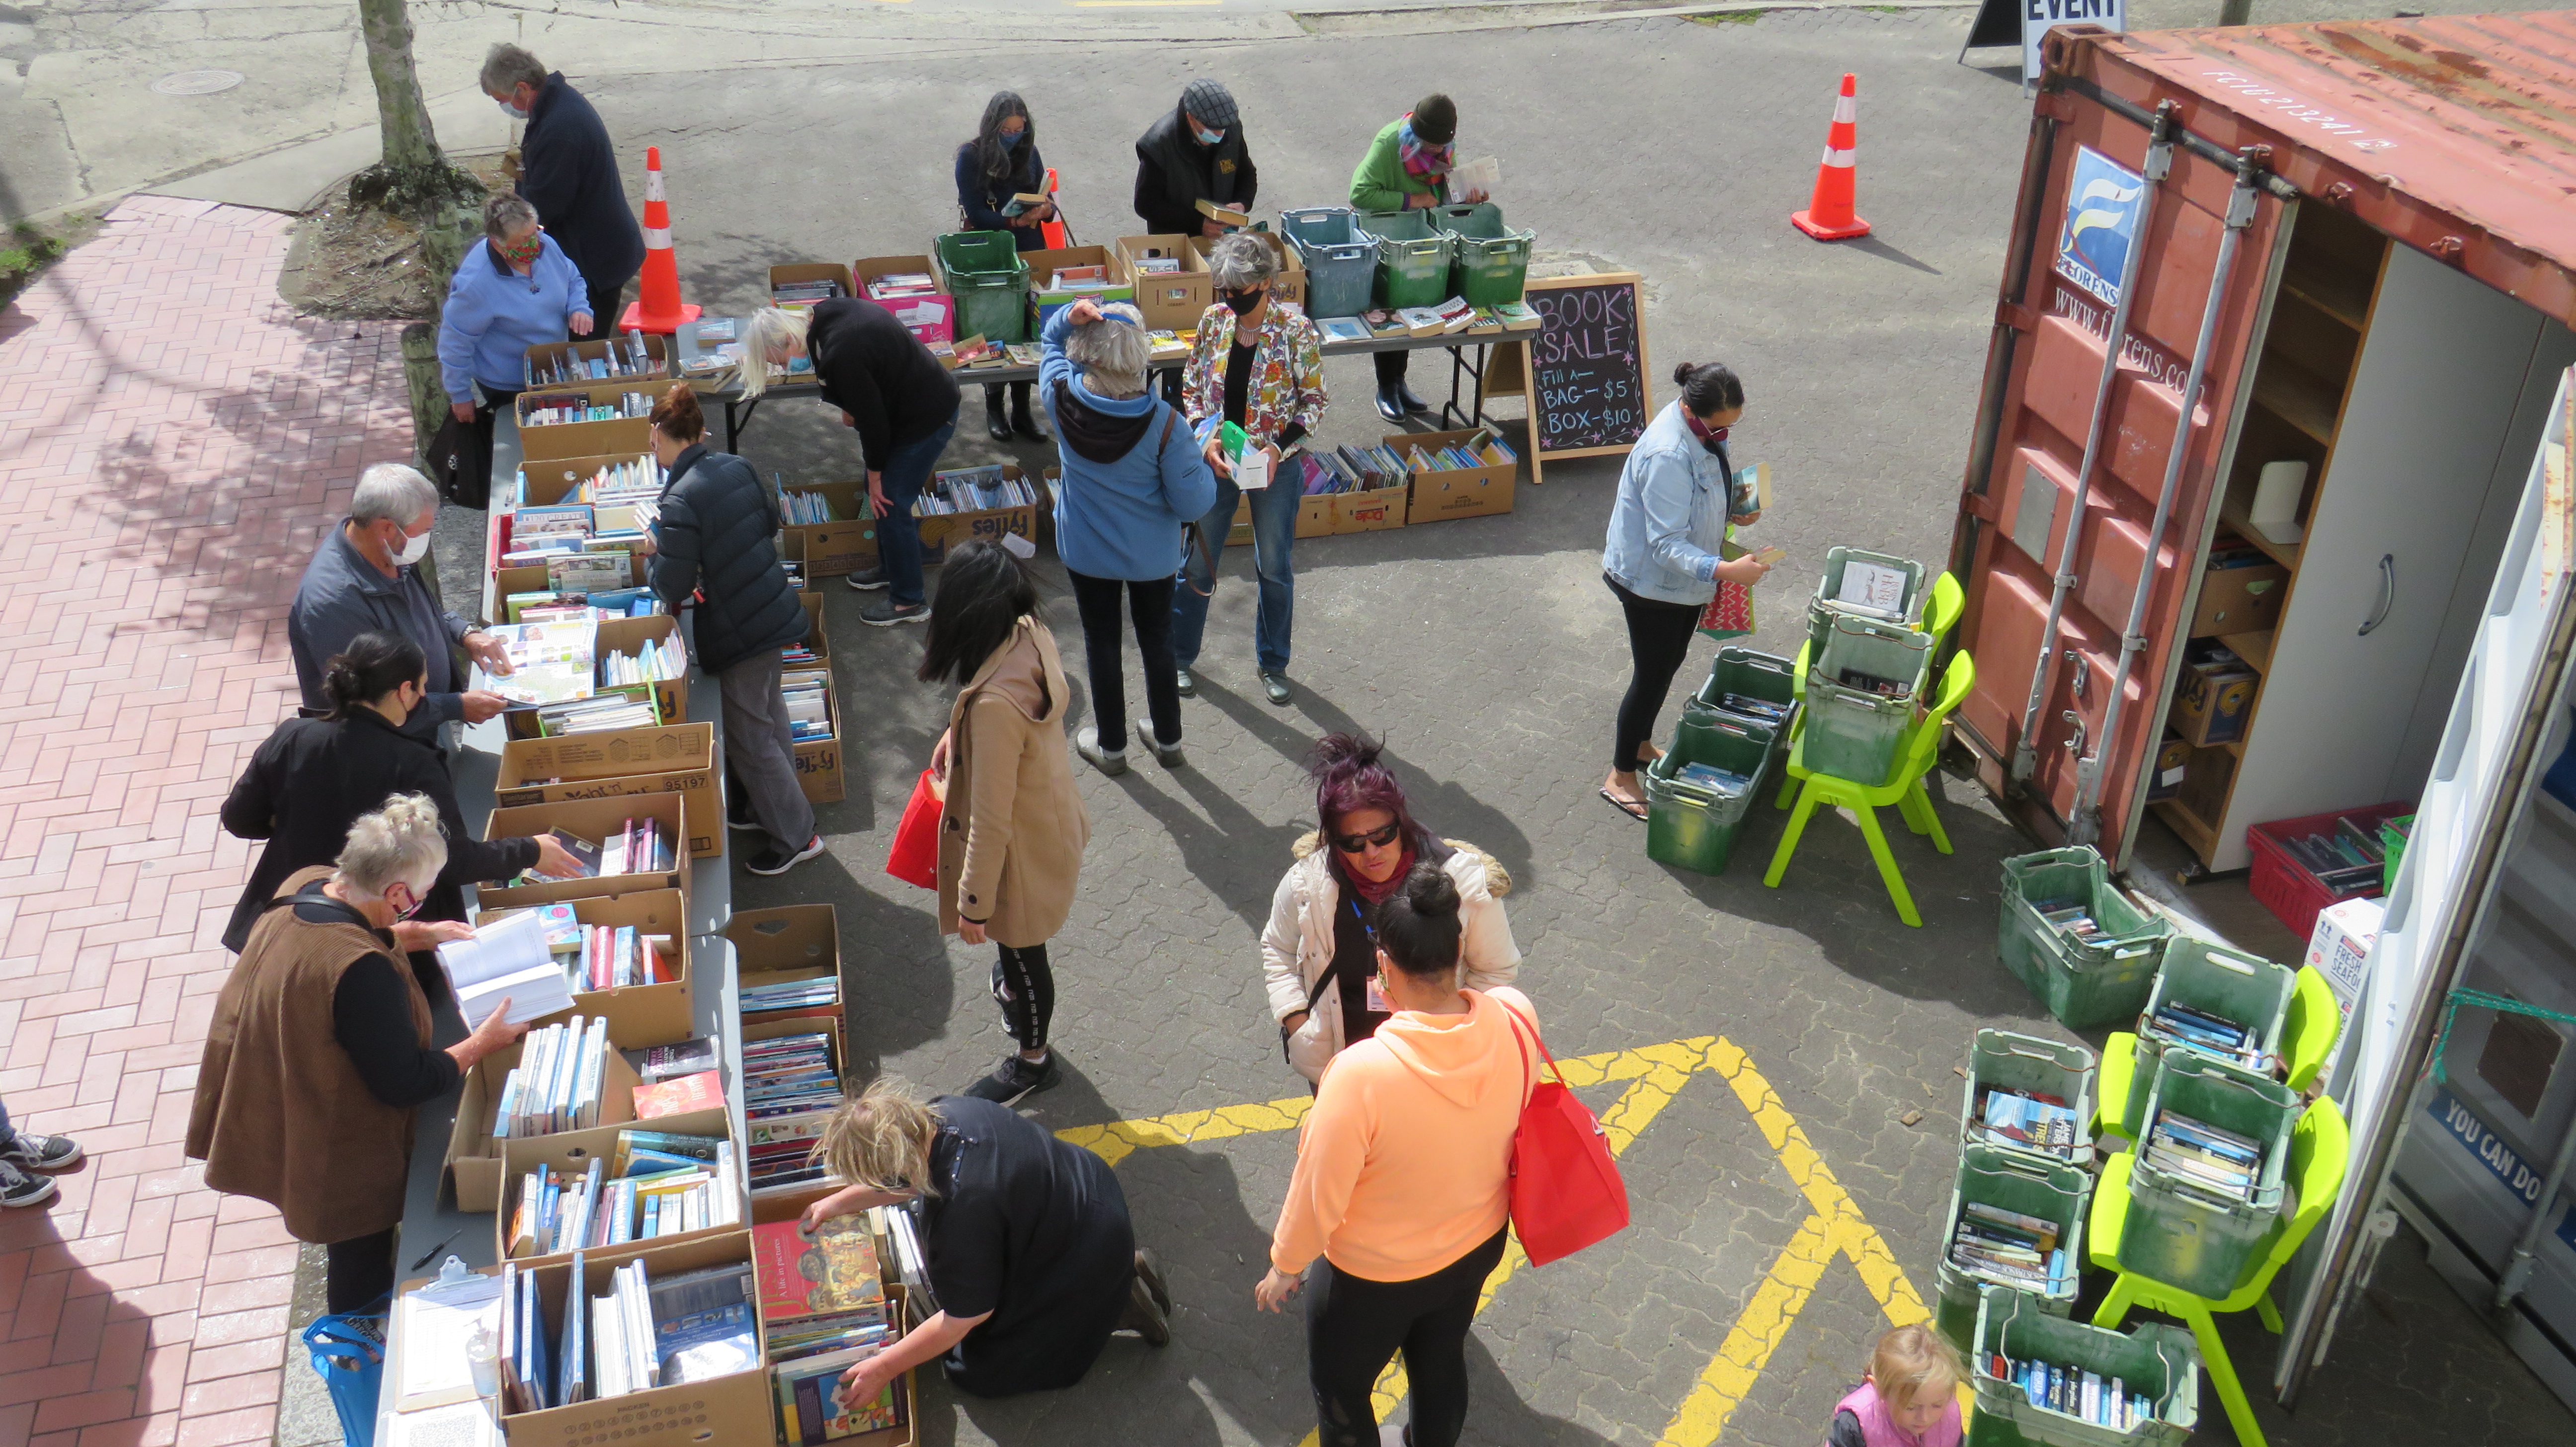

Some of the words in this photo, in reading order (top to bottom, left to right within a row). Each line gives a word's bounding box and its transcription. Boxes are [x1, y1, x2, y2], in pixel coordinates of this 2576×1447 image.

[1534, 290, 1626, 331] BOOK
[1543, 326, 1624, 363] SALE
[2056, 287, 2205, 409] www.flrens.co
[1604, 379, 1628, 402] $5
[1355, 510, 1383, 523] Dole
[1878, 574, 1894, 605] HOBB
[665, 777, 706, 790] 95197
[2335, 945, 2362, 974] FRESH
[2445, 1098, 2482, 1143] YOU
[2479, 1132, 2515, 1177] CAN
[2512, 1164, 2542, 1202] DO
[774, 1238, 785, 1266] pictures
[756, 1233, 805, 1310] JESUS
[779, 1267, 785, 1276] in
